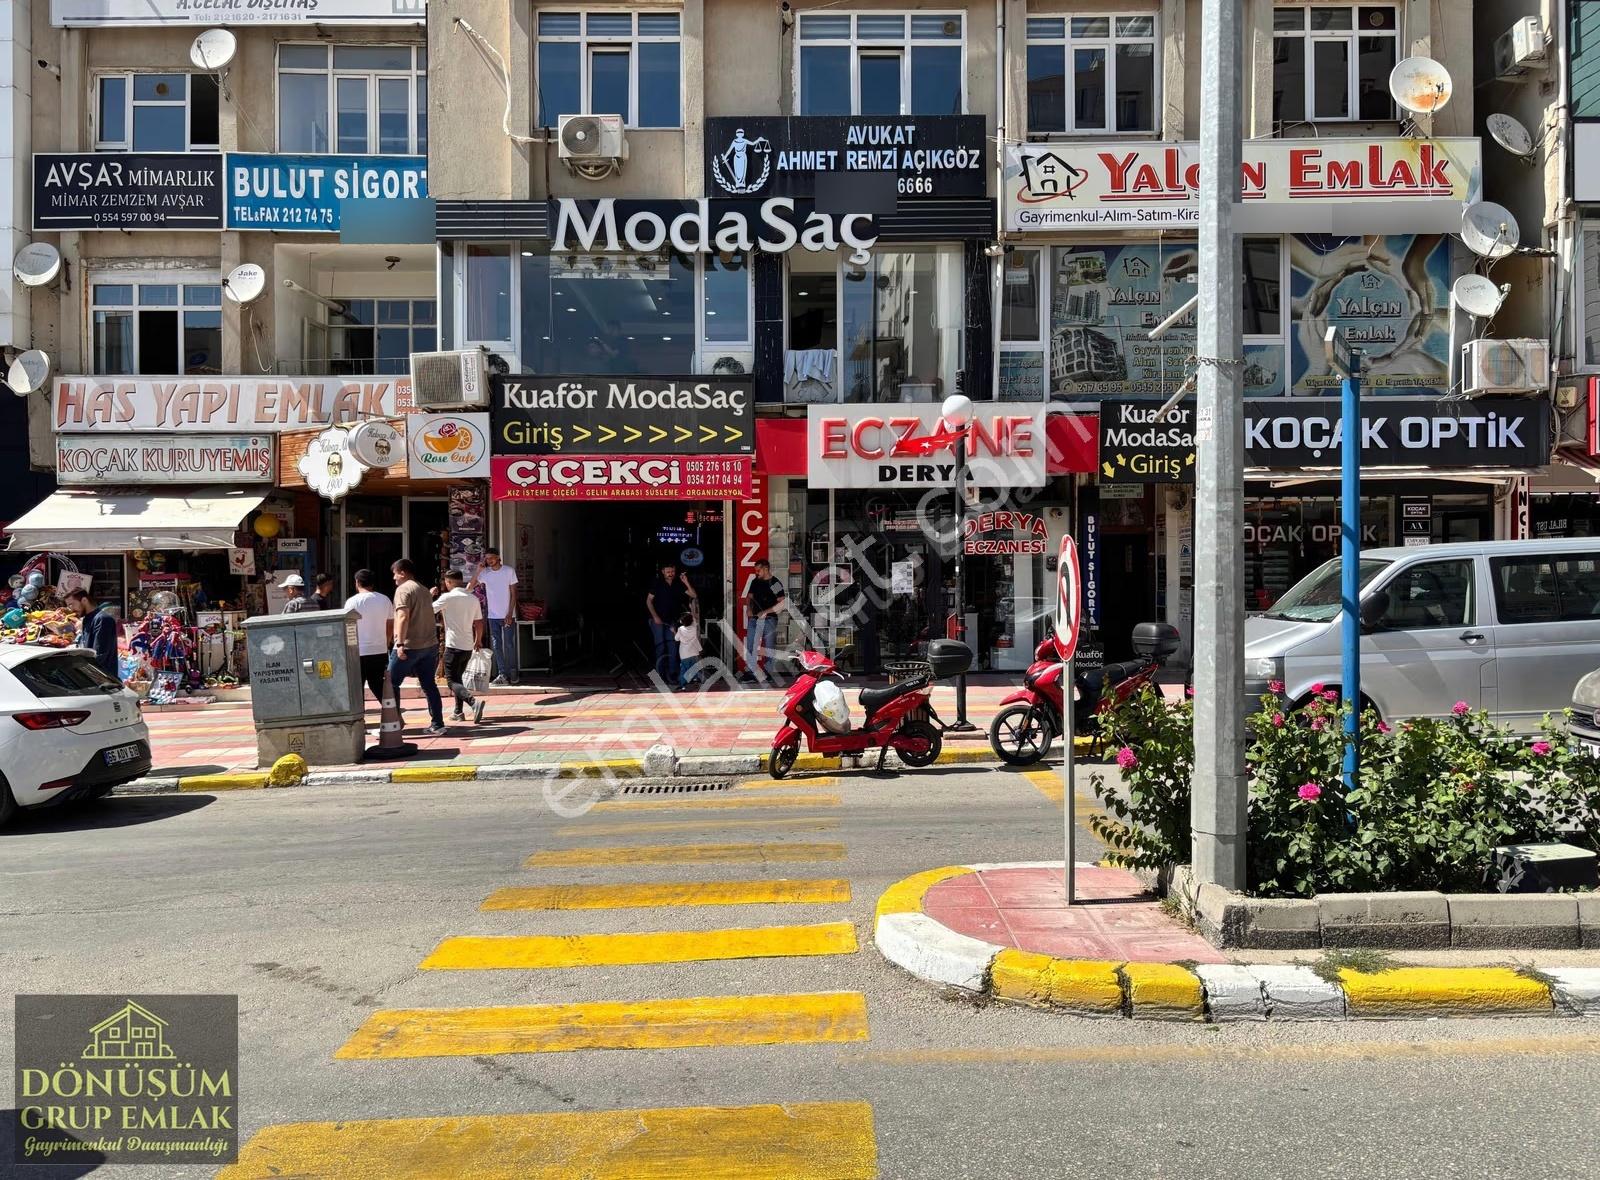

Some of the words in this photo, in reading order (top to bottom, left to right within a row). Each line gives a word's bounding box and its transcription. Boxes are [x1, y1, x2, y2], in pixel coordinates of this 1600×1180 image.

[846, 125, 916, 146] AVUKAT
[776, 151, 837, 170] AHMET
[845, 146, 898, 170] REMZİ
[902, 147, 980, 177] AÇIKGÖZ
[44, 162, 124, 191] AVŞAR
[128, 167, 216, 188] MİMARLIK
[233, 167, 325, 199] BULUT
[51, 192, 99, 207] MİMAR
[101, 193, 158, 207] ZEMZEM
[161, 193, 205, 210] AVŞAR
[94, 213, 100, 222] 0
[102, 213, 119, 222] 554
[121, 213, 138, 222] 597
[140, 213, 152, 222] 00
[153, 213, 166, 222] 94
[233, 206, 280, 223] TEL&FAX
[282, 207, 302, 223] 212
[304, 208, 318, 224] 74
[320, 208, 334, 224] 75
[550, 197, 880, 265] ModaSaç
[57, 382, 138, 429] HAS
[152, 382, 242, 429] YAPI
[254, 382, 391, 429] EMLAK
[501, 383, 598, 410] Kuaför
[605, 383, 747, 416] ModaSaç
[502, 420, 564, 450] Giriş
[1400, 410, 1525, 449] OPTİK
[58, 446, 139, 478] KOÇAK
[141, 437, 271, 477] KURUYEMİŞ
[420, 453, 449, 464] Rose
[450, 452, 476, 463] Cafe
[686, 461, 704, 472] 0505
[706, 461, 720, 472] 276
[722, 461, 731, 471] 18
[733, 461, 742, 471] 10
[1130, 453, 1182, 479] Giriş
[585, 489, 608, 497] GELİN
[610, 489, 643, 497] ARABASI
[645, 488, 679, 497] SÜSLEME
[686, 489, 743, 497] ORGANİZASYON
[686, 474, 704, 485] 0354
[706, 474, 720, 485] 217
[722, 474, 732, 485] 04
[733, 474, 742, 485] 94
[1087, 515, 1096, 560] BULUT
[1242, 525, 1303, 546] OÇAK
[1087, 561, 1097, 625] SİGORTA
[1075, 650, 1104, 659] Kuaför
[1075, 661, 1104, 669] ModaSaç
